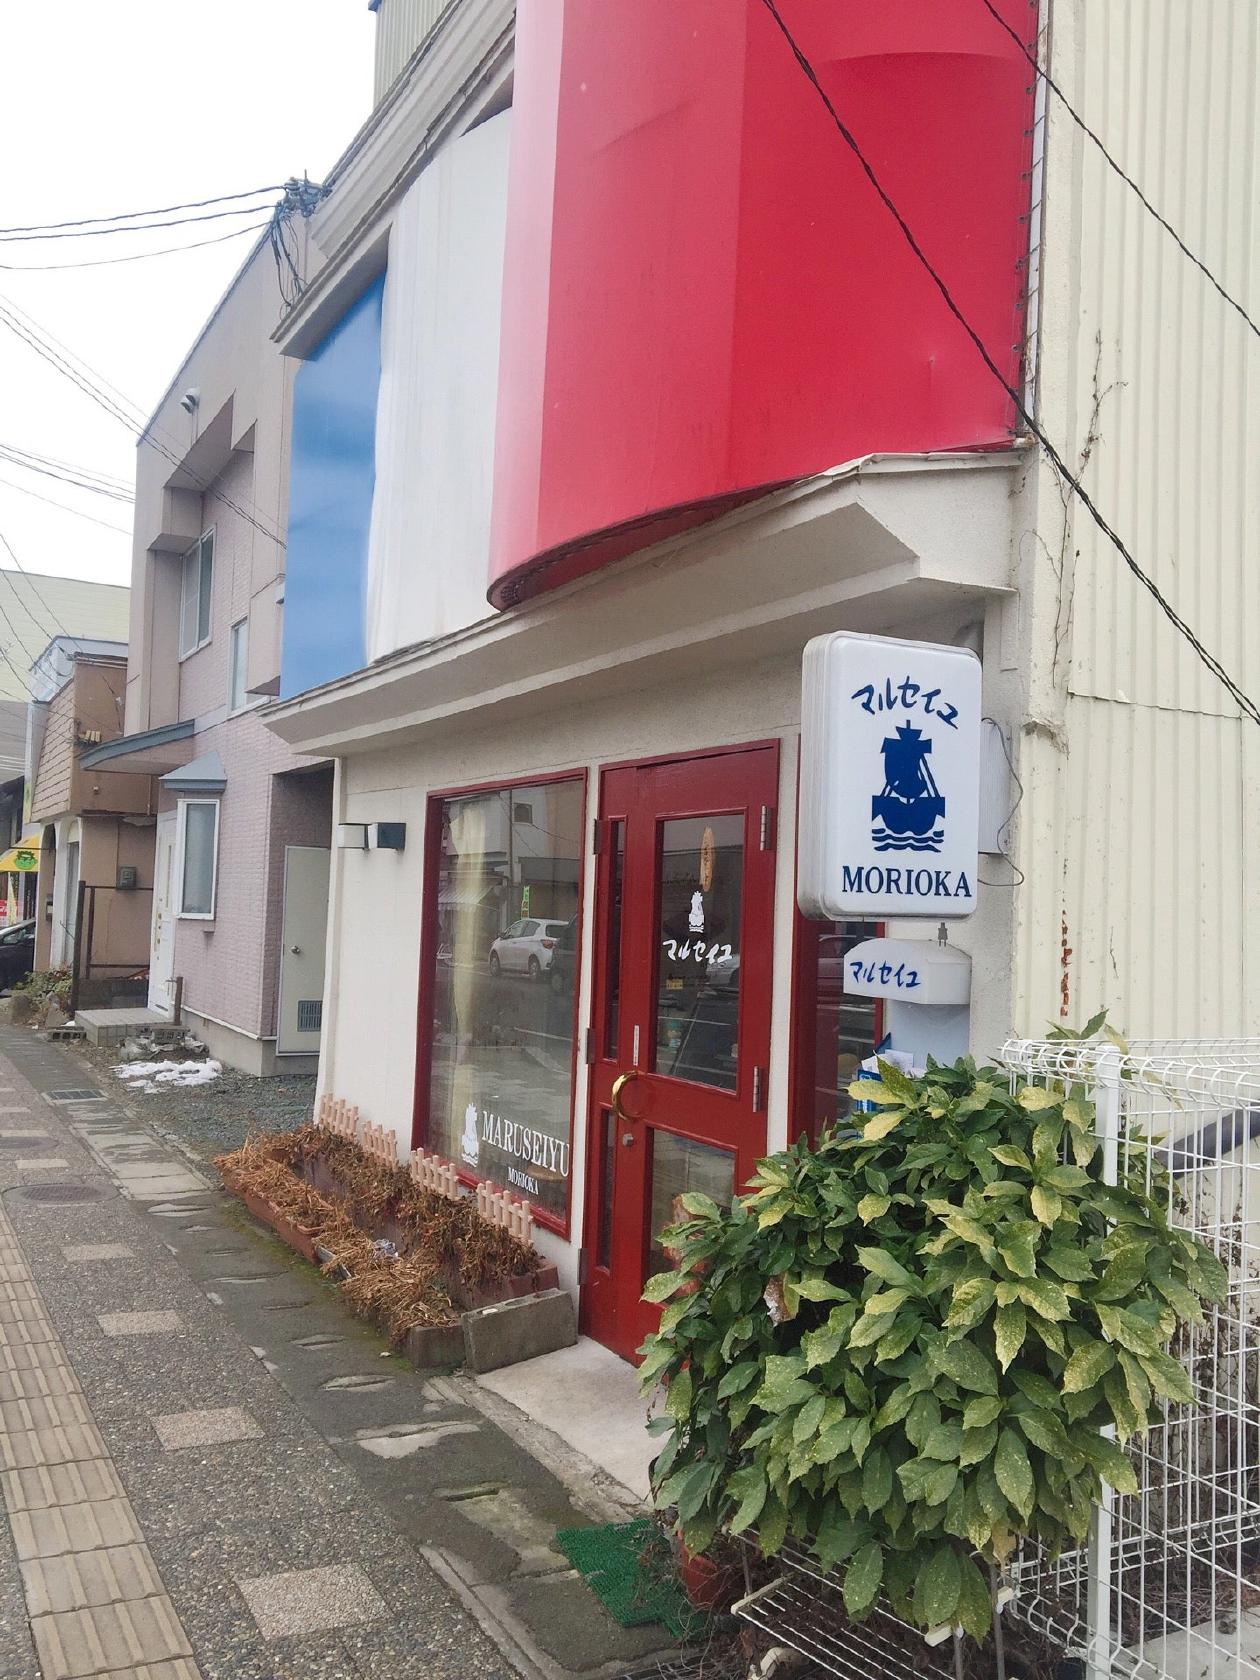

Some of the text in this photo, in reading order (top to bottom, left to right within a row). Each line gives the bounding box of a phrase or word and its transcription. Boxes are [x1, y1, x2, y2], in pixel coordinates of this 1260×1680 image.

[842, 866, 972, 898] MORIOKA
[482, 1111, 570, 1177] MARUSEIYU
[507, 1167, 539, 1195] MORIOKA
